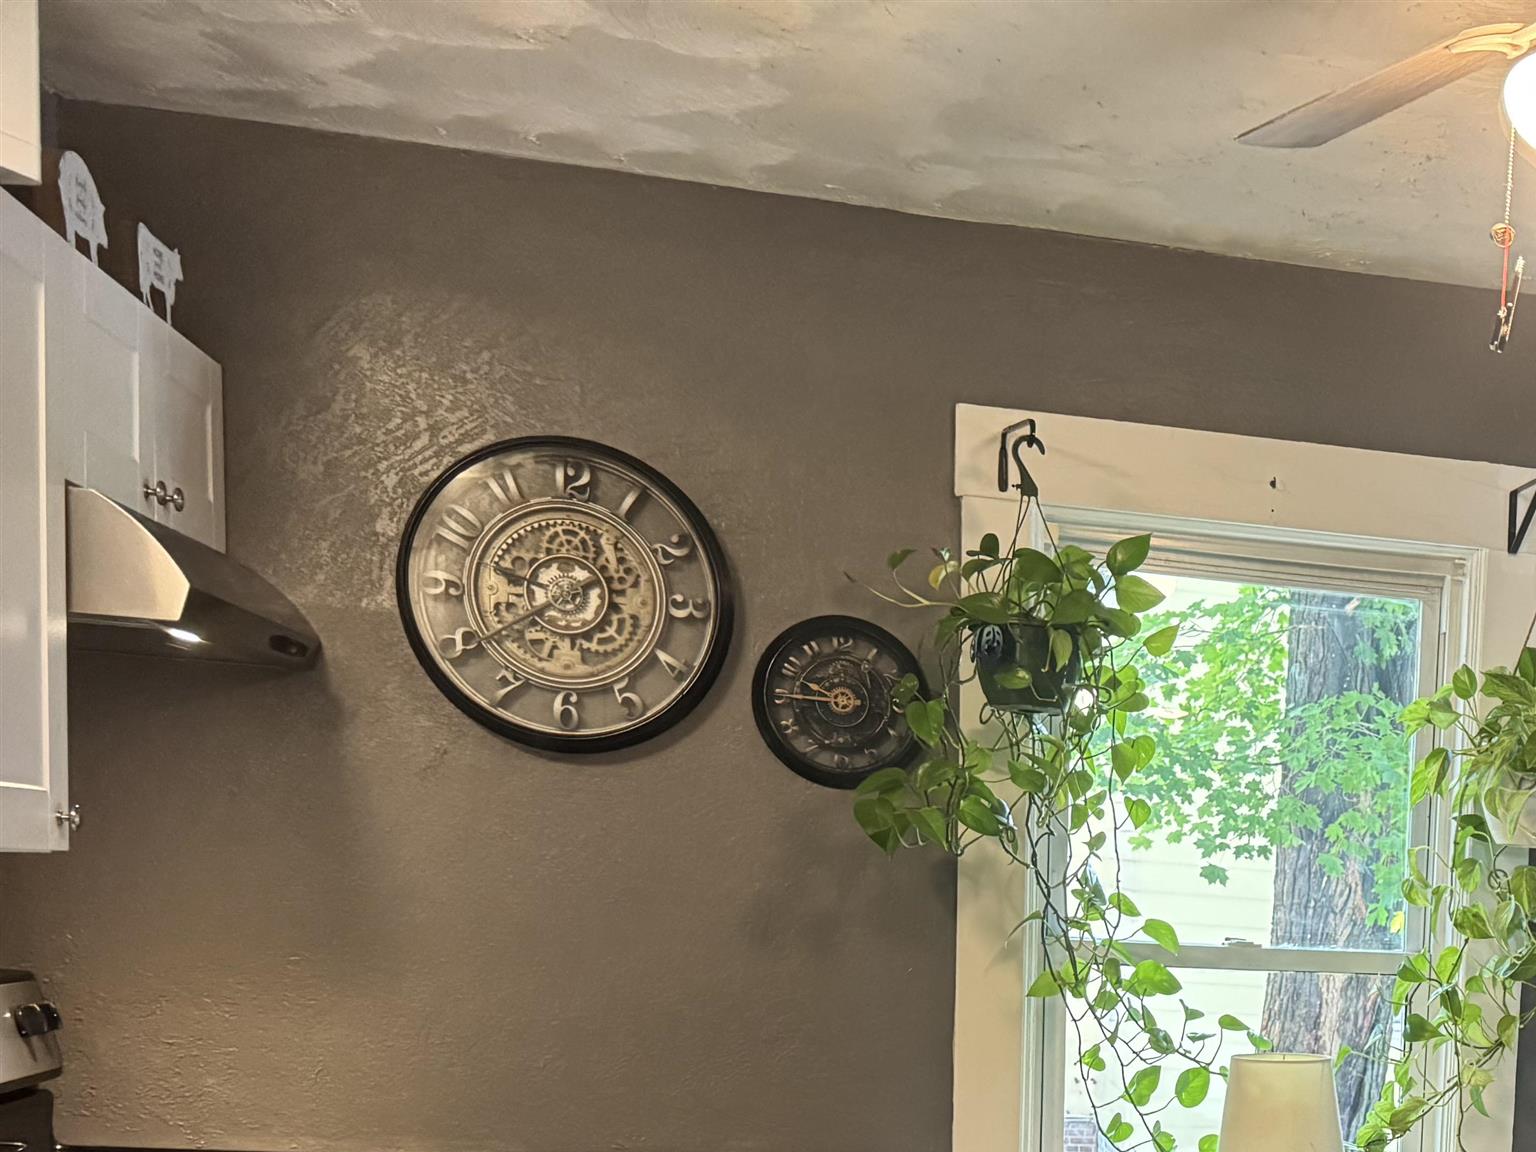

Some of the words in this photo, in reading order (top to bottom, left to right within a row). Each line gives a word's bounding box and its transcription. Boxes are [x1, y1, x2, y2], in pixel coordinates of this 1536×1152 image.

[555, 461, 591, 501] 12
[434, 503, 485, 548] 10
[652, 533, 691, 565] 2
[422, 569, 463, 597] 9
[668, 593, 711, 619] 3
[438, 627, 478, 659] 8
[654, 648, 688, 681] 4
[552, 690, 579, 730] 6
[613, 676, 644, 719] 5
